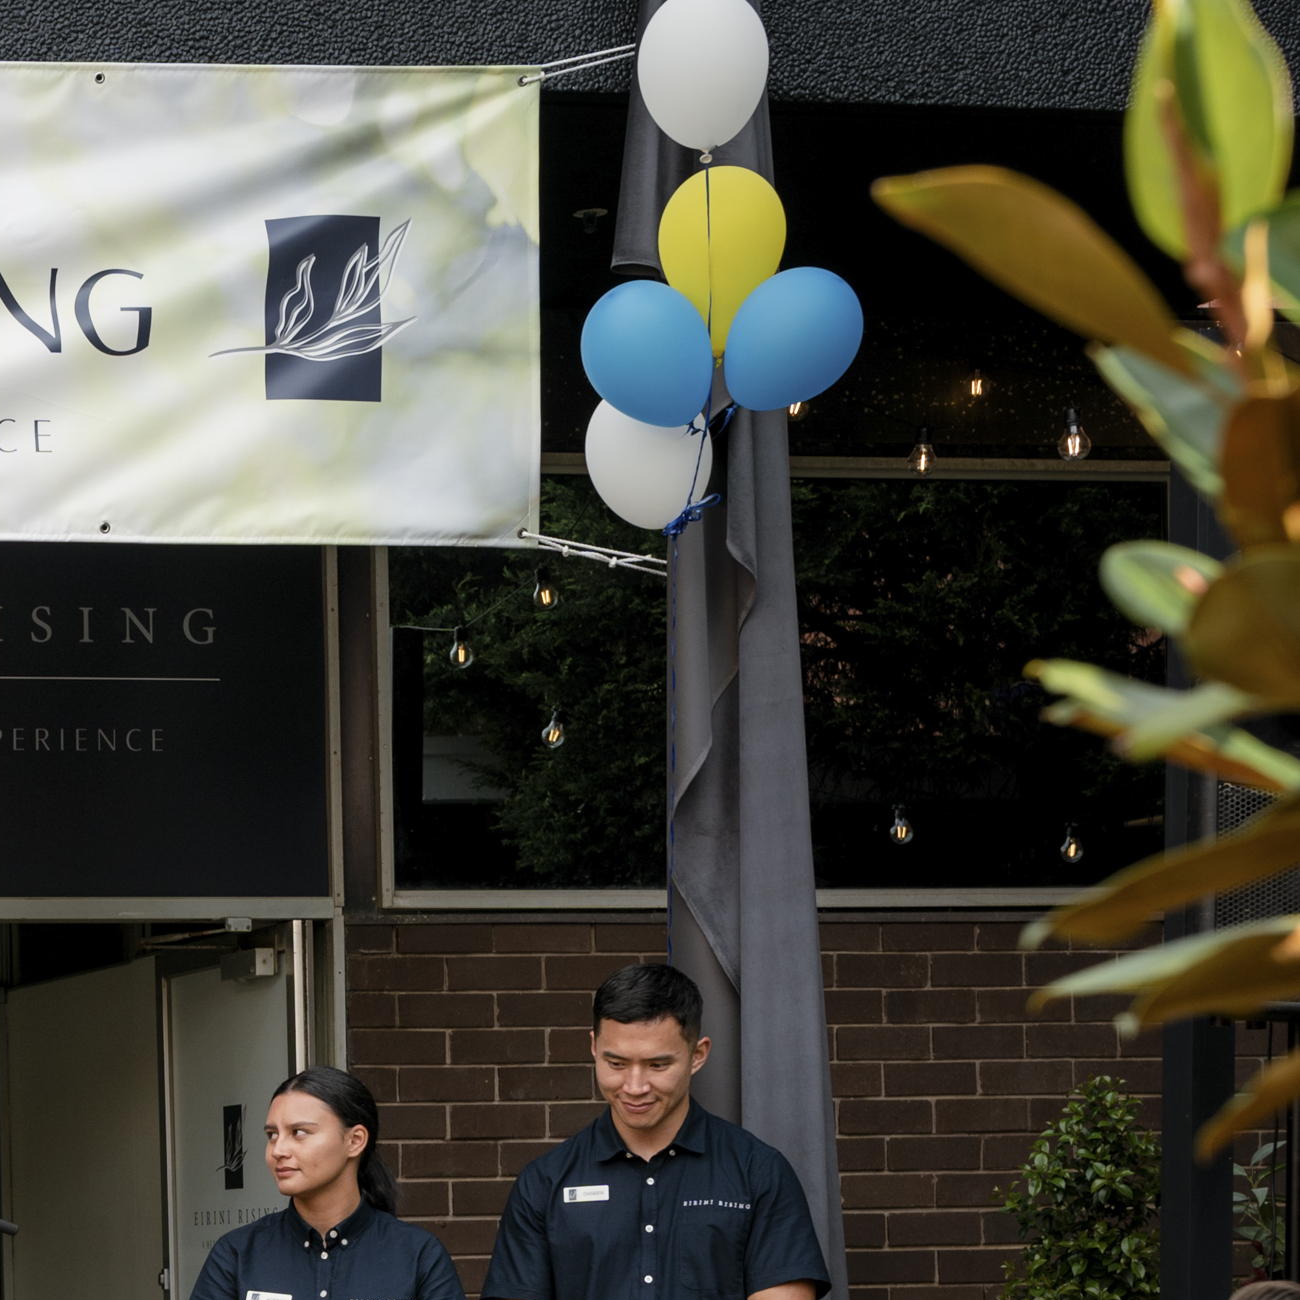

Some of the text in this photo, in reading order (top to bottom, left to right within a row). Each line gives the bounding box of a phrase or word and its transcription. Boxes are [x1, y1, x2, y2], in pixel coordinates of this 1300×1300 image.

[683, 1199, 751, 1210] EIRINI RISING
[194, 1209, 231, 1226] EIRINI
